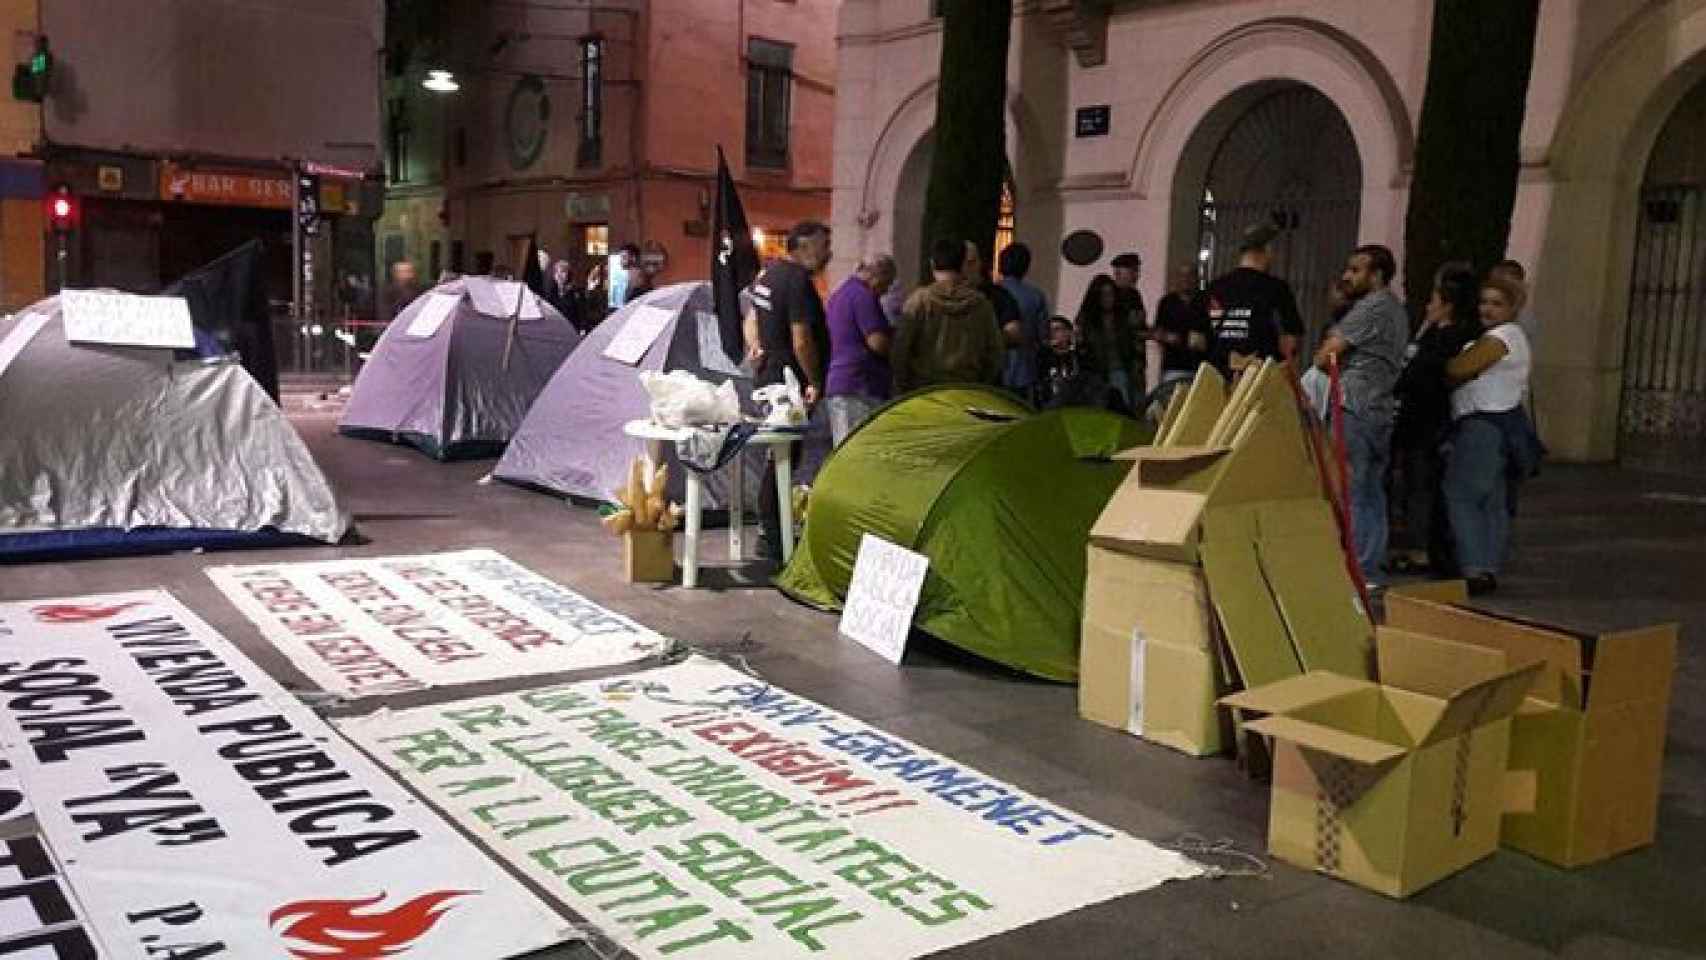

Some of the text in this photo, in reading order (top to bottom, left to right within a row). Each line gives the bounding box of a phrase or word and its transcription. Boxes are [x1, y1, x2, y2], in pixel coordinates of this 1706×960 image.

[191, 174, 236, 193] BAR
[0, 657, 146, 763] SOCIAL
[558, 708, 689, 762] PARC
[198, 714, 421, 866] PÚBLICA
[378, 728, 484, 774] PER
[527, 836, 754, 955] CIUTAT
[440, 705, 864, 952] DE LLOGUER SOCIAL
